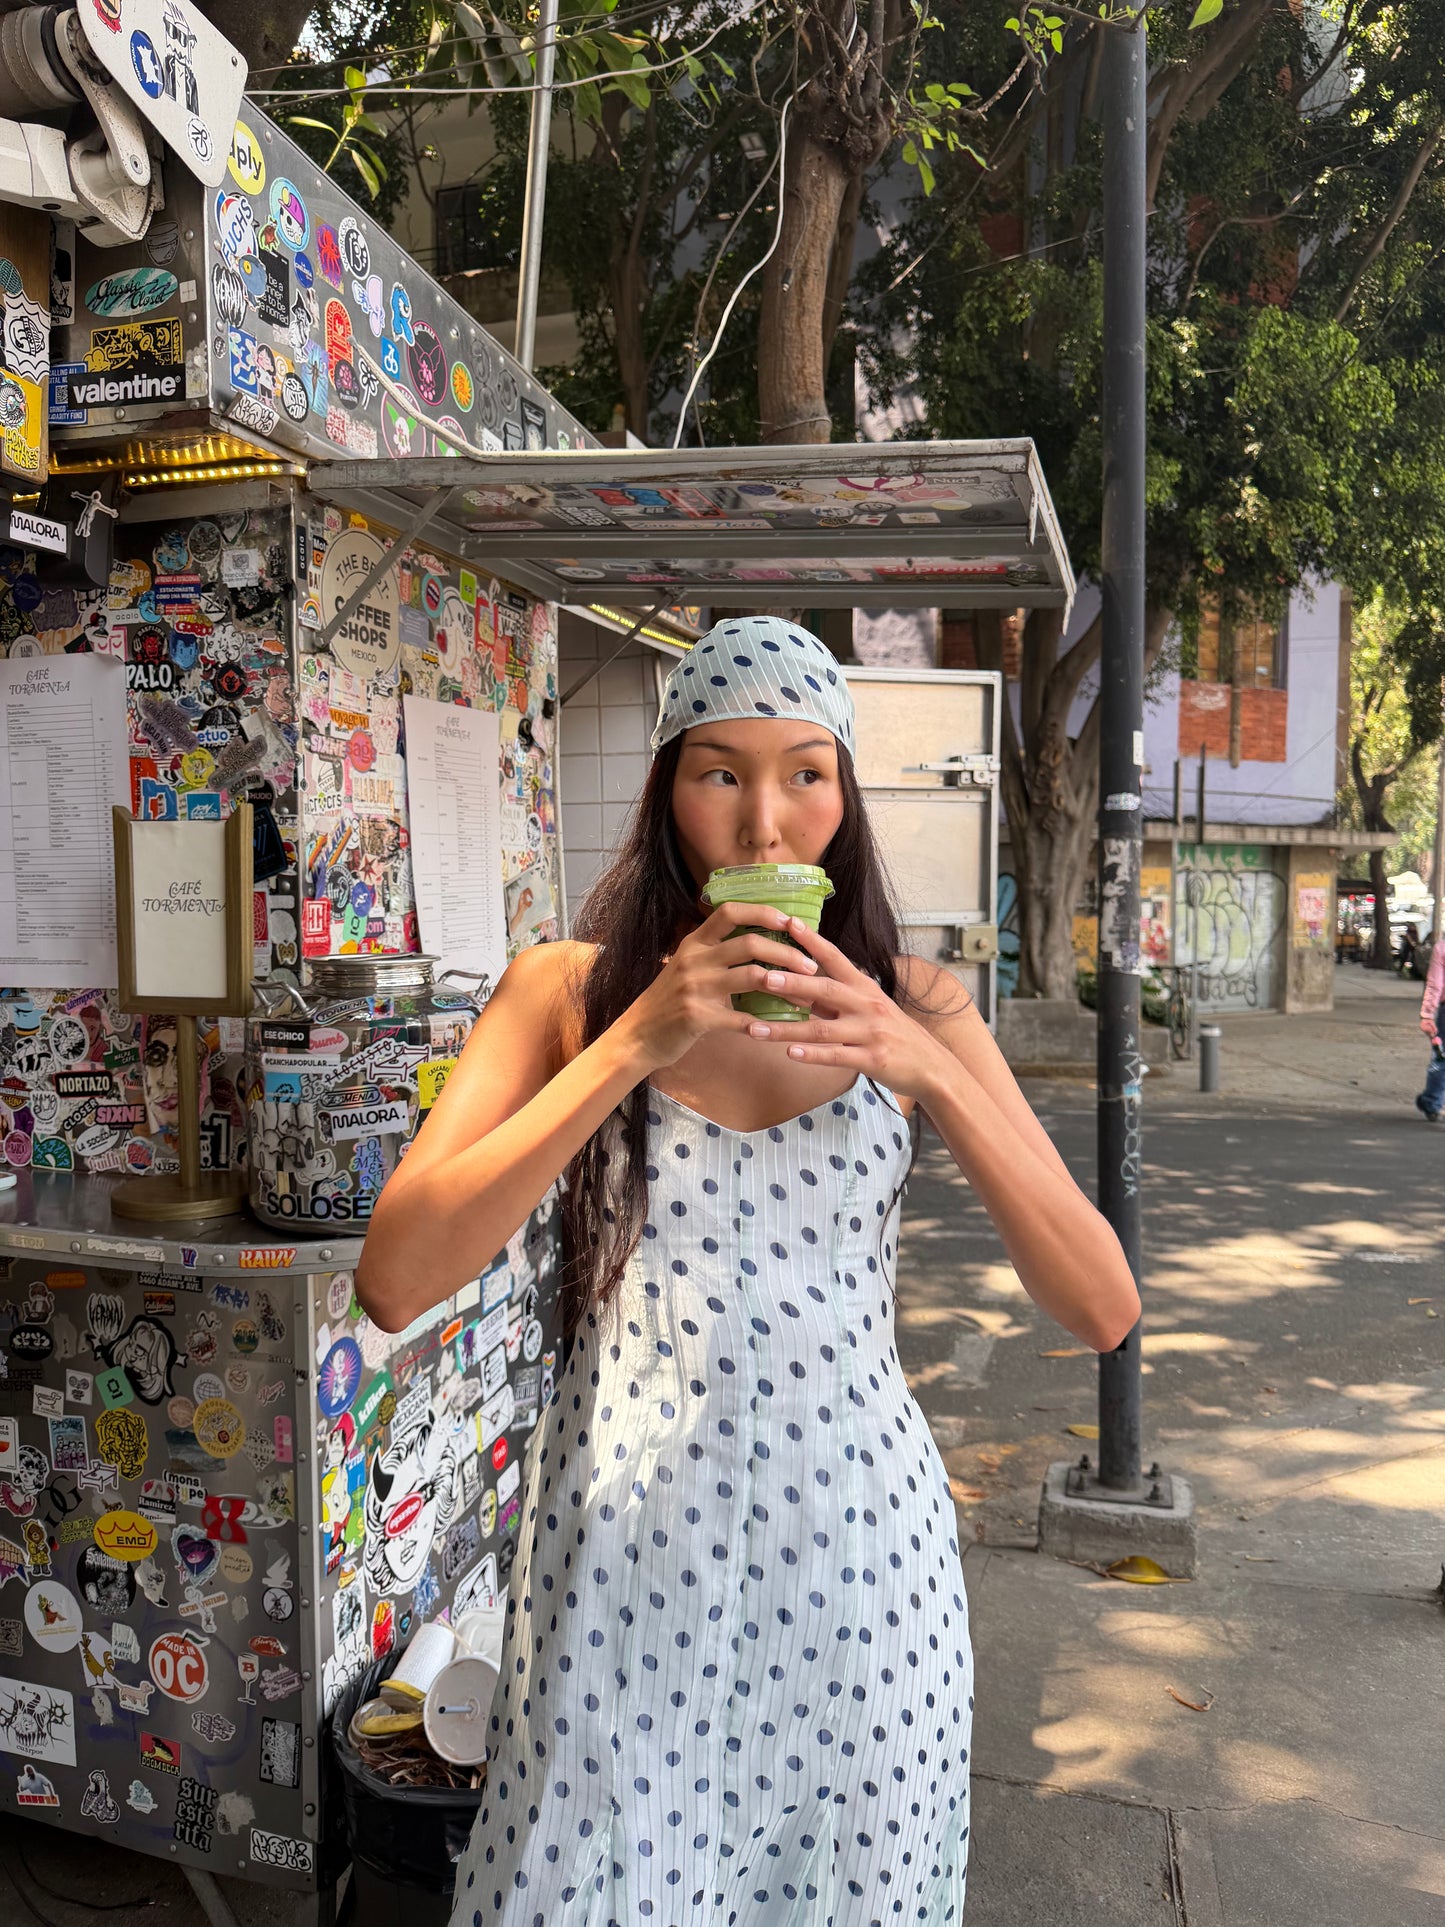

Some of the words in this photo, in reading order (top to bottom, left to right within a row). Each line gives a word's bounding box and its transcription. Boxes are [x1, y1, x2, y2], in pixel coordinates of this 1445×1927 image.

[222, 198, 253, 268] FUCHS
[97, 279, 140, 298] Classic
[131, 292, 166, 310] Closet
[336, 554, 358, 579] THE
[884, 565, 1000, 574] Supreme
[335, 595, 392, 631] CFFEE
[338, 621, 388, 650] SHOPS
[351, 648, 378, 664] MEXICO
[26, 667, 51, 684] CAFÉ
[9, 680, 71, 697] TORMENTA
[168, 879, 203, 899] CAFÉ
[264, 1030, 278, 1039] ESE
[278, 1031, 305, 1042] CHICO
[59, 1075, 110, 1094] NORTAZO
[63, 1097, 99, 1131] CLOSER
[97, 1105, 146, 1123] SIXNE
[161, 1638, 185, 1655] MADE
[186, 1644, 197, 1656] IN
[153, 1649, 200, 1695] OC
